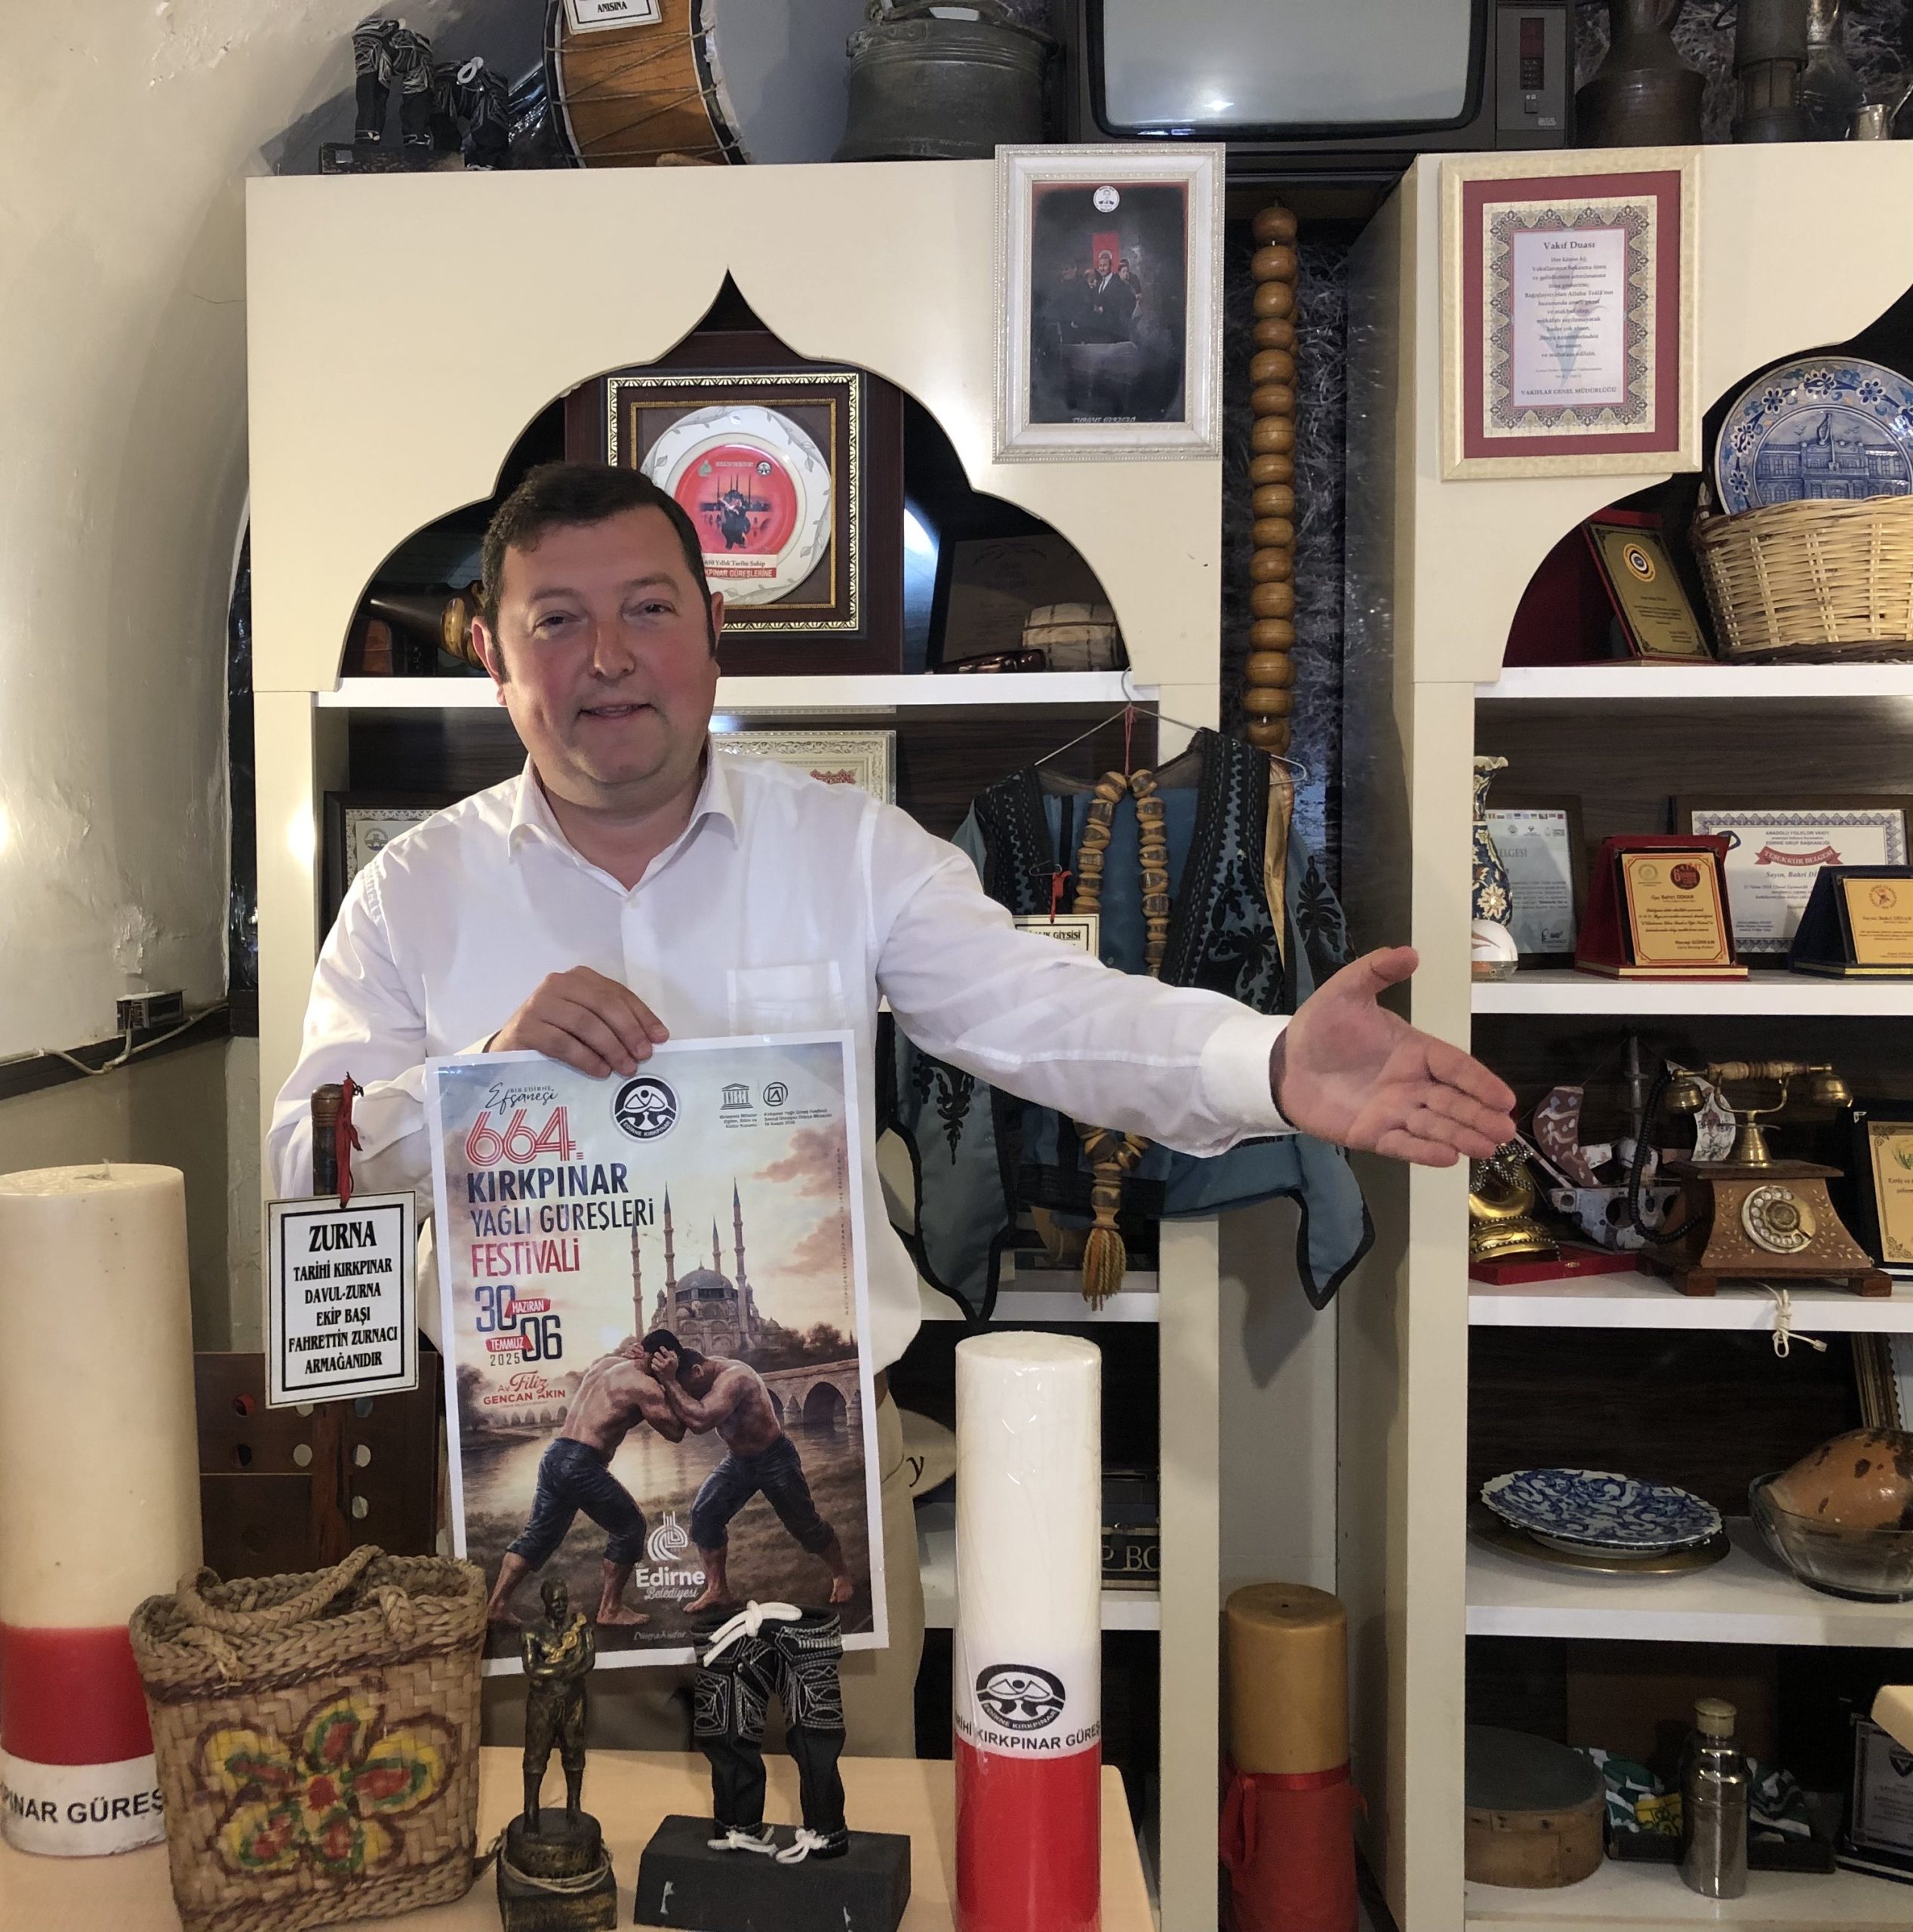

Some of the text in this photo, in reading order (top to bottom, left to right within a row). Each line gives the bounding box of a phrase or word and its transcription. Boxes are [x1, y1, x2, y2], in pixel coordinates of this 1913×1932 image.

[597, 1, 628, 14] ANISINA
[1543, 241, 1595, 250] Vakıf Duası
[1053, 929, 1081, 940] GİYSİSİ
[467, 1162, 629, 1204] KIRKPINAR
[470, 1198, 654, 1238] YAĞLI GÜREŞLERİ
[308, 1220, 377, 1253] ZURNA
[293, 1257, 392, 1281] TARİHİ KIRKPINAR
[471, 1238, 580, 1278] FESTİVALİ
[304, 1282, 382, 1304] DAVUL-ZURNA
[316, 1306, 371, 1327] EKİP BAŞI
[475, 1284, 518, 1332] 30
[512, 1300, 545, 1314] HAZİRAN
[288, 1326, 398, 1352] FAHRETTİN ZURNACI
[491, 1337, 524, 1351] TEMMUZ
[520, 1315, 563, 1362] 06
[305, 1351, 383, 1374] ARMAĞANIDIR
[490, 1352, 520, 1367] 2025
[509, 1371, 549, 1394] Filiz
[483, 1392, 533, 1405] GENCAN
[537, 1389, 566, 1400] AKIN
[635, 1566, 706, 1588] Edirne
[644, 1586, 700, 1602] Belediyesi
